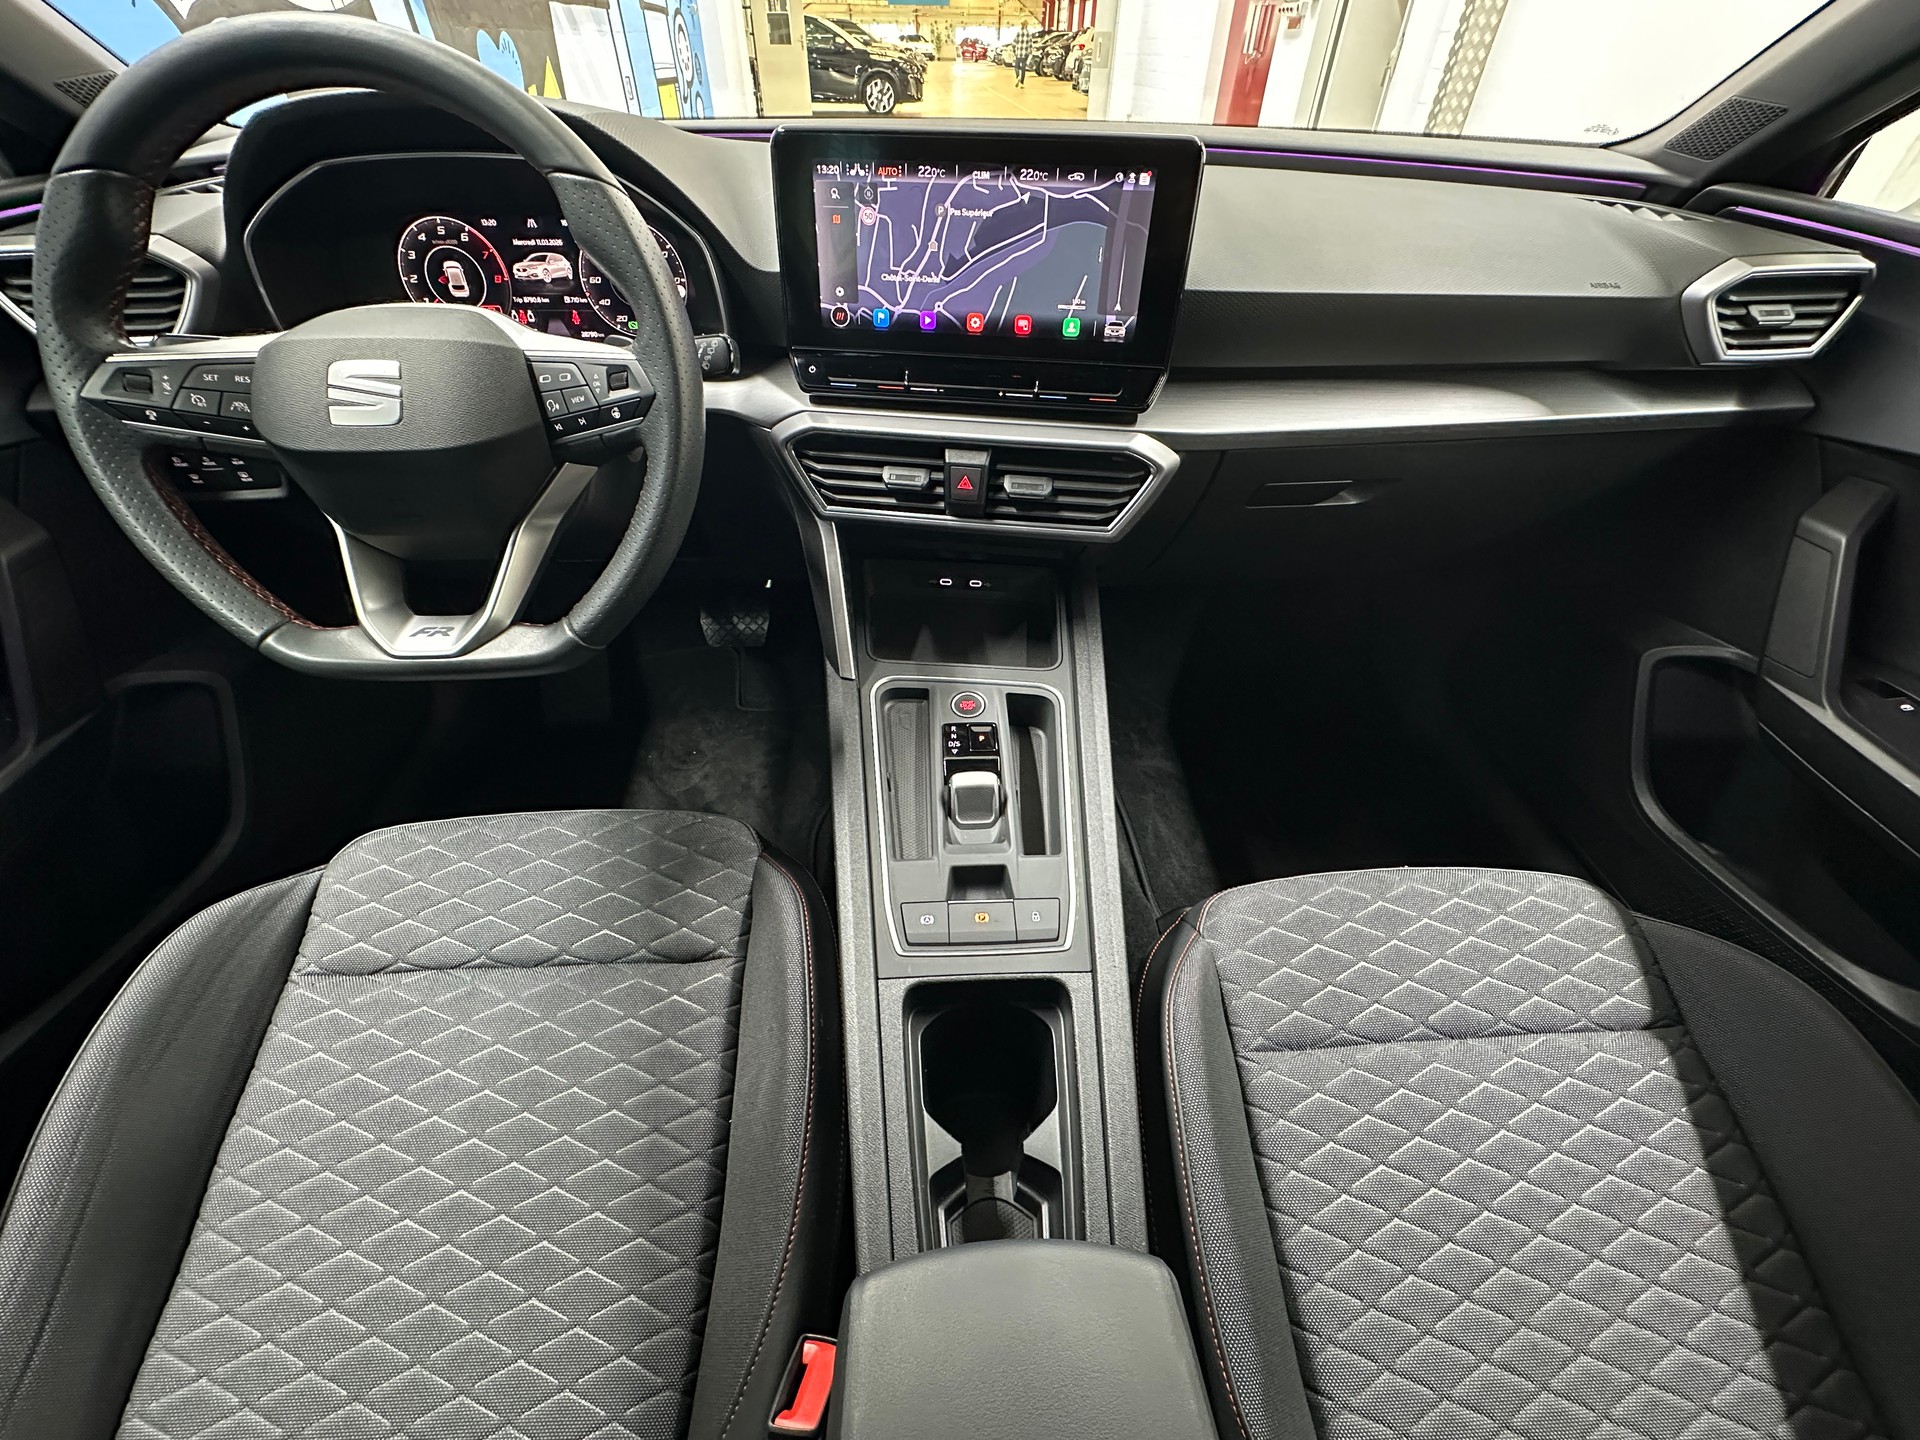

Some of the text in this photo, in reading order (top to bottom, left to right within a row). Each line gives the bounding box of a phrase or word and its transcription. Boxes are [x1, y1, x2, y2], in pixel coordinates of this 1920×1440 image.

[816, 164, 840, 175] 13:20
[878, 166, 898, 176] AUTO
[972, 171, 991, 180] CLIM
[864, 211, 873, 220] 50
[437, 226, 445, 235] 5
[418, 233, 427, 241] 4
[461, 233, 469, 242] 6
[408, 251, 416, 259] 3
[482, 251, 489, 259] 7
[410, 275, 418, 283] 2
[494, 275, 502, 283] 8
[589, 276, 602, 284] 60
[1589, 282, 1622, 290] AIRBAG
[203, 374, 219, 382] SET
[234, 375, 251, 384] RES
[570, 395, 585, 404] VIEW
[409, 627, 455, 637] FR
